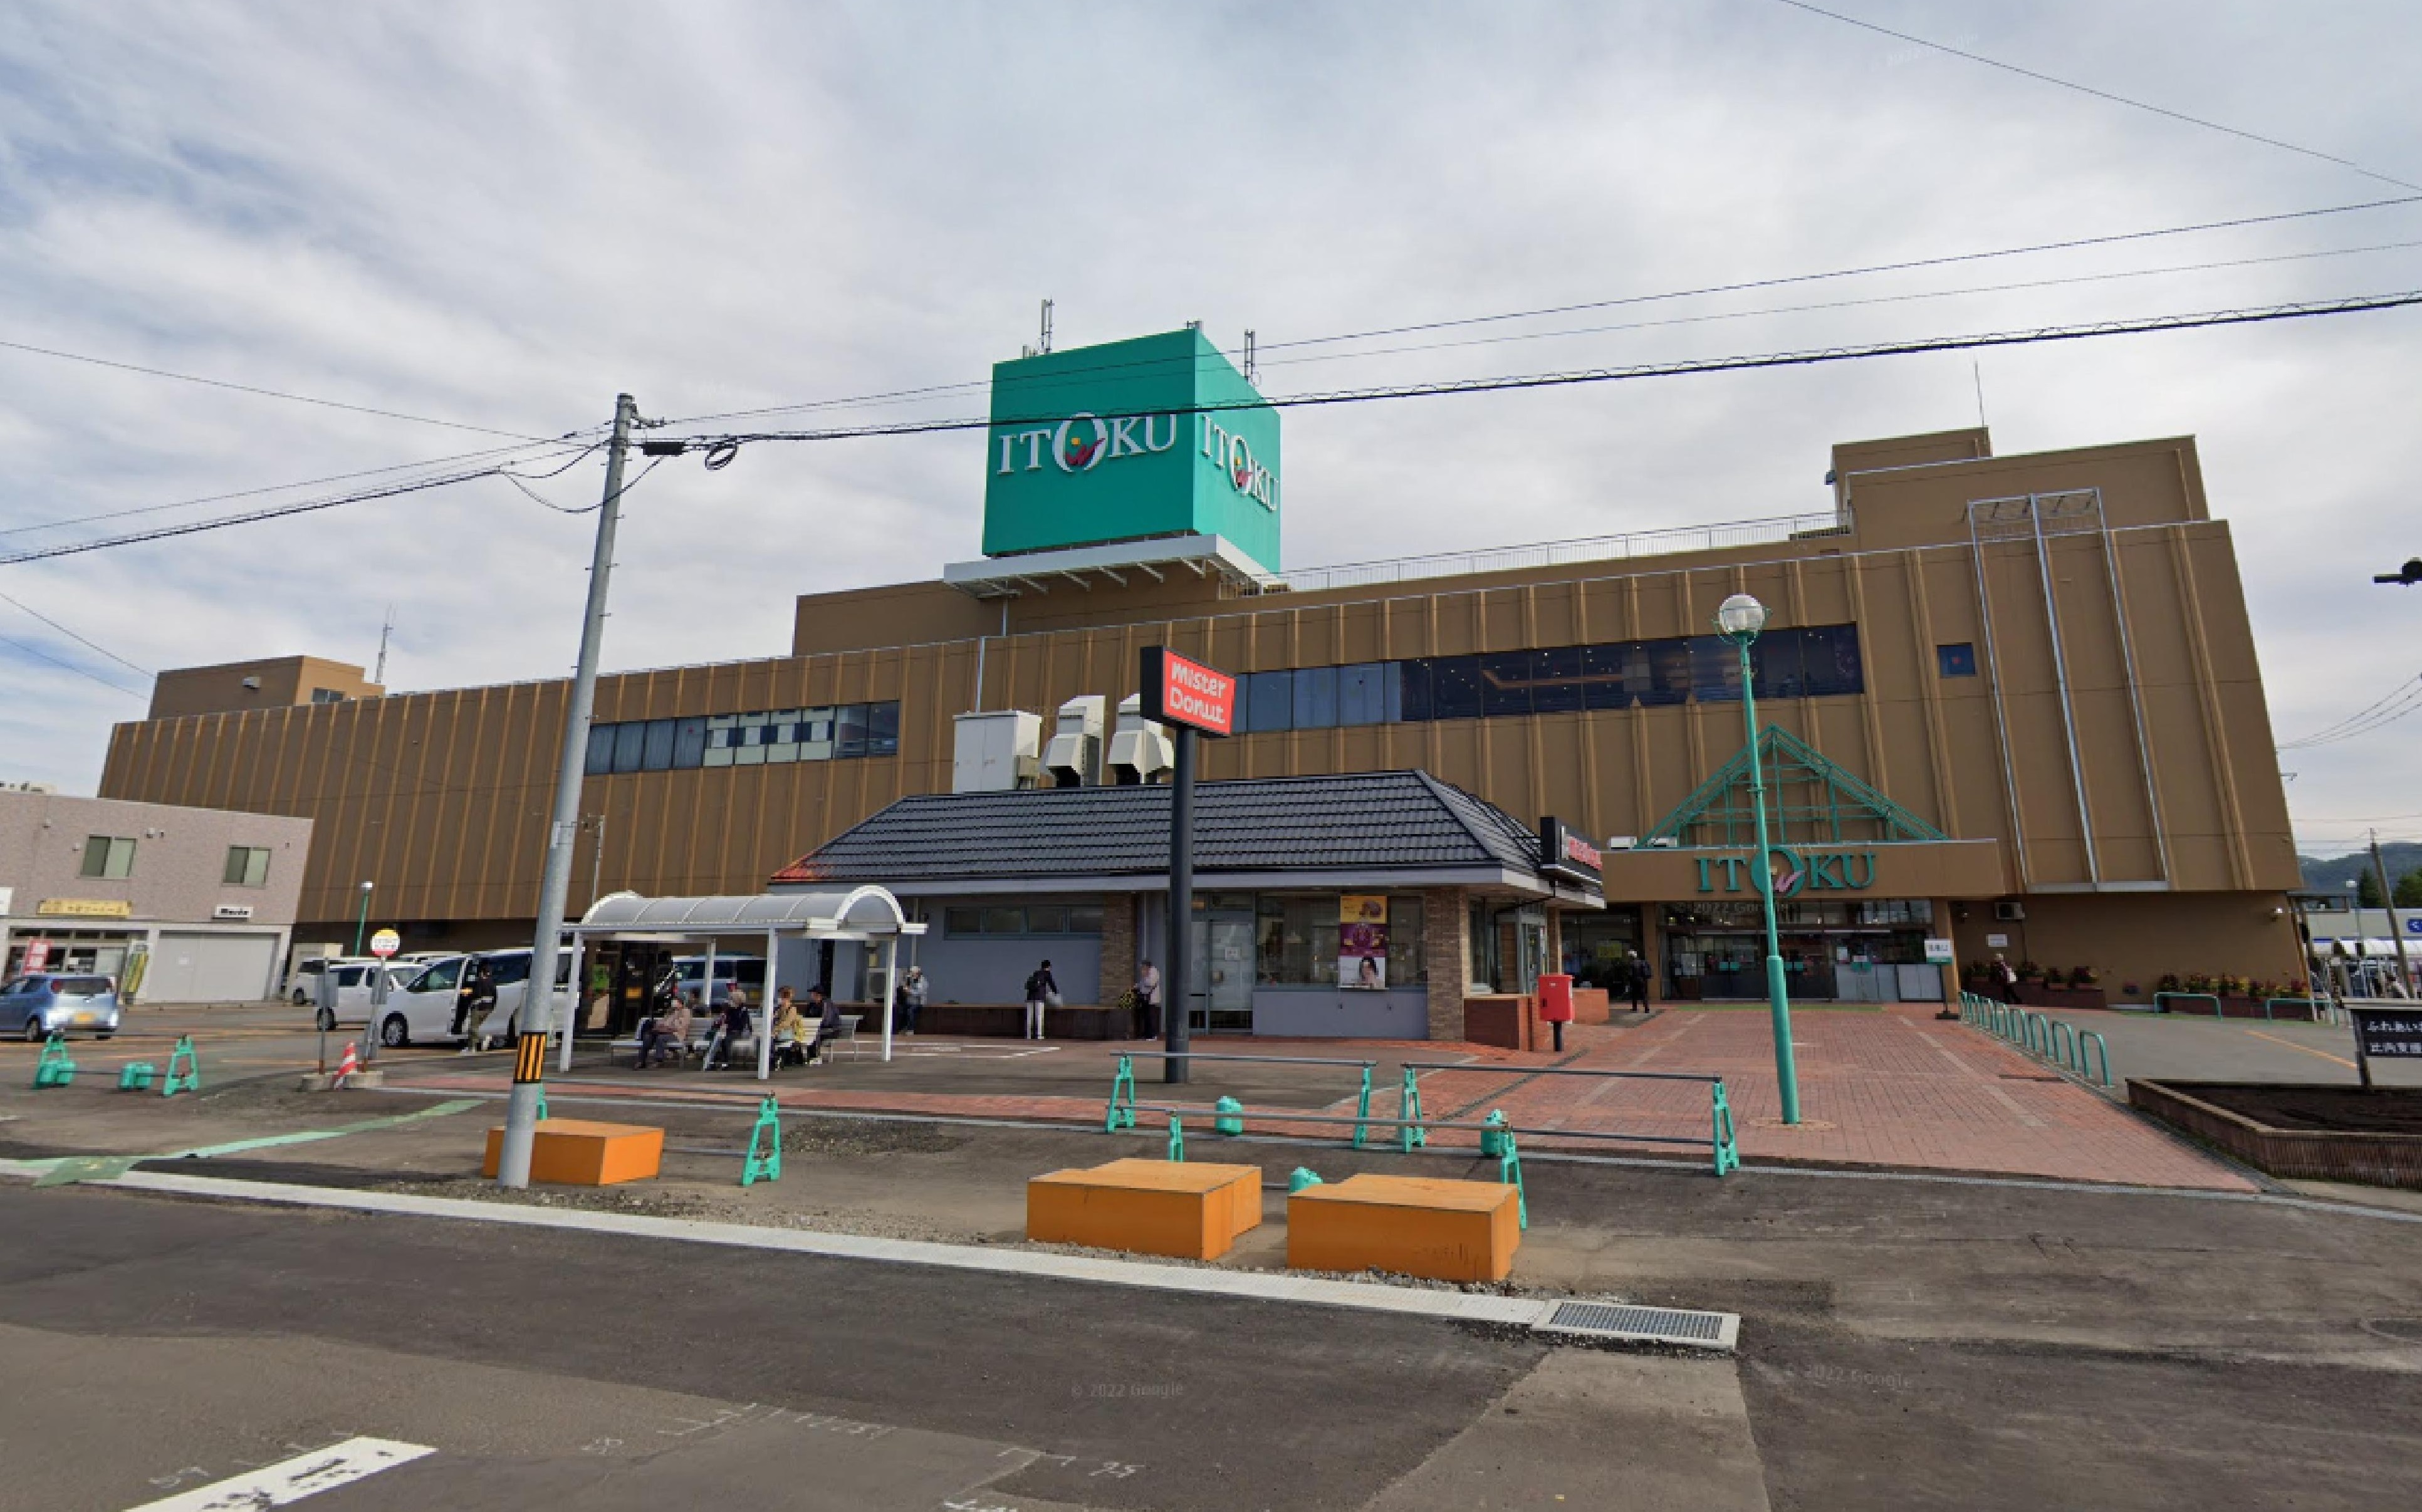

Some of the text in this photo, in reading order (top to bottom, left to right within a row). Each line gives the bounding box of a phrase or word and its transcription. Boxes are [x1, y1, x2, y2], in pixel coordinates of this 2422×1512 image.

[996, 412, 1176, 474] ITOKU
[1201, 414, 1278, 512] ITOKU
[1169, 686, 1226, 724] Donut
[1171, 662, 1227, 699] Mister
[1694, 847, 1876, 898] ITOKU
